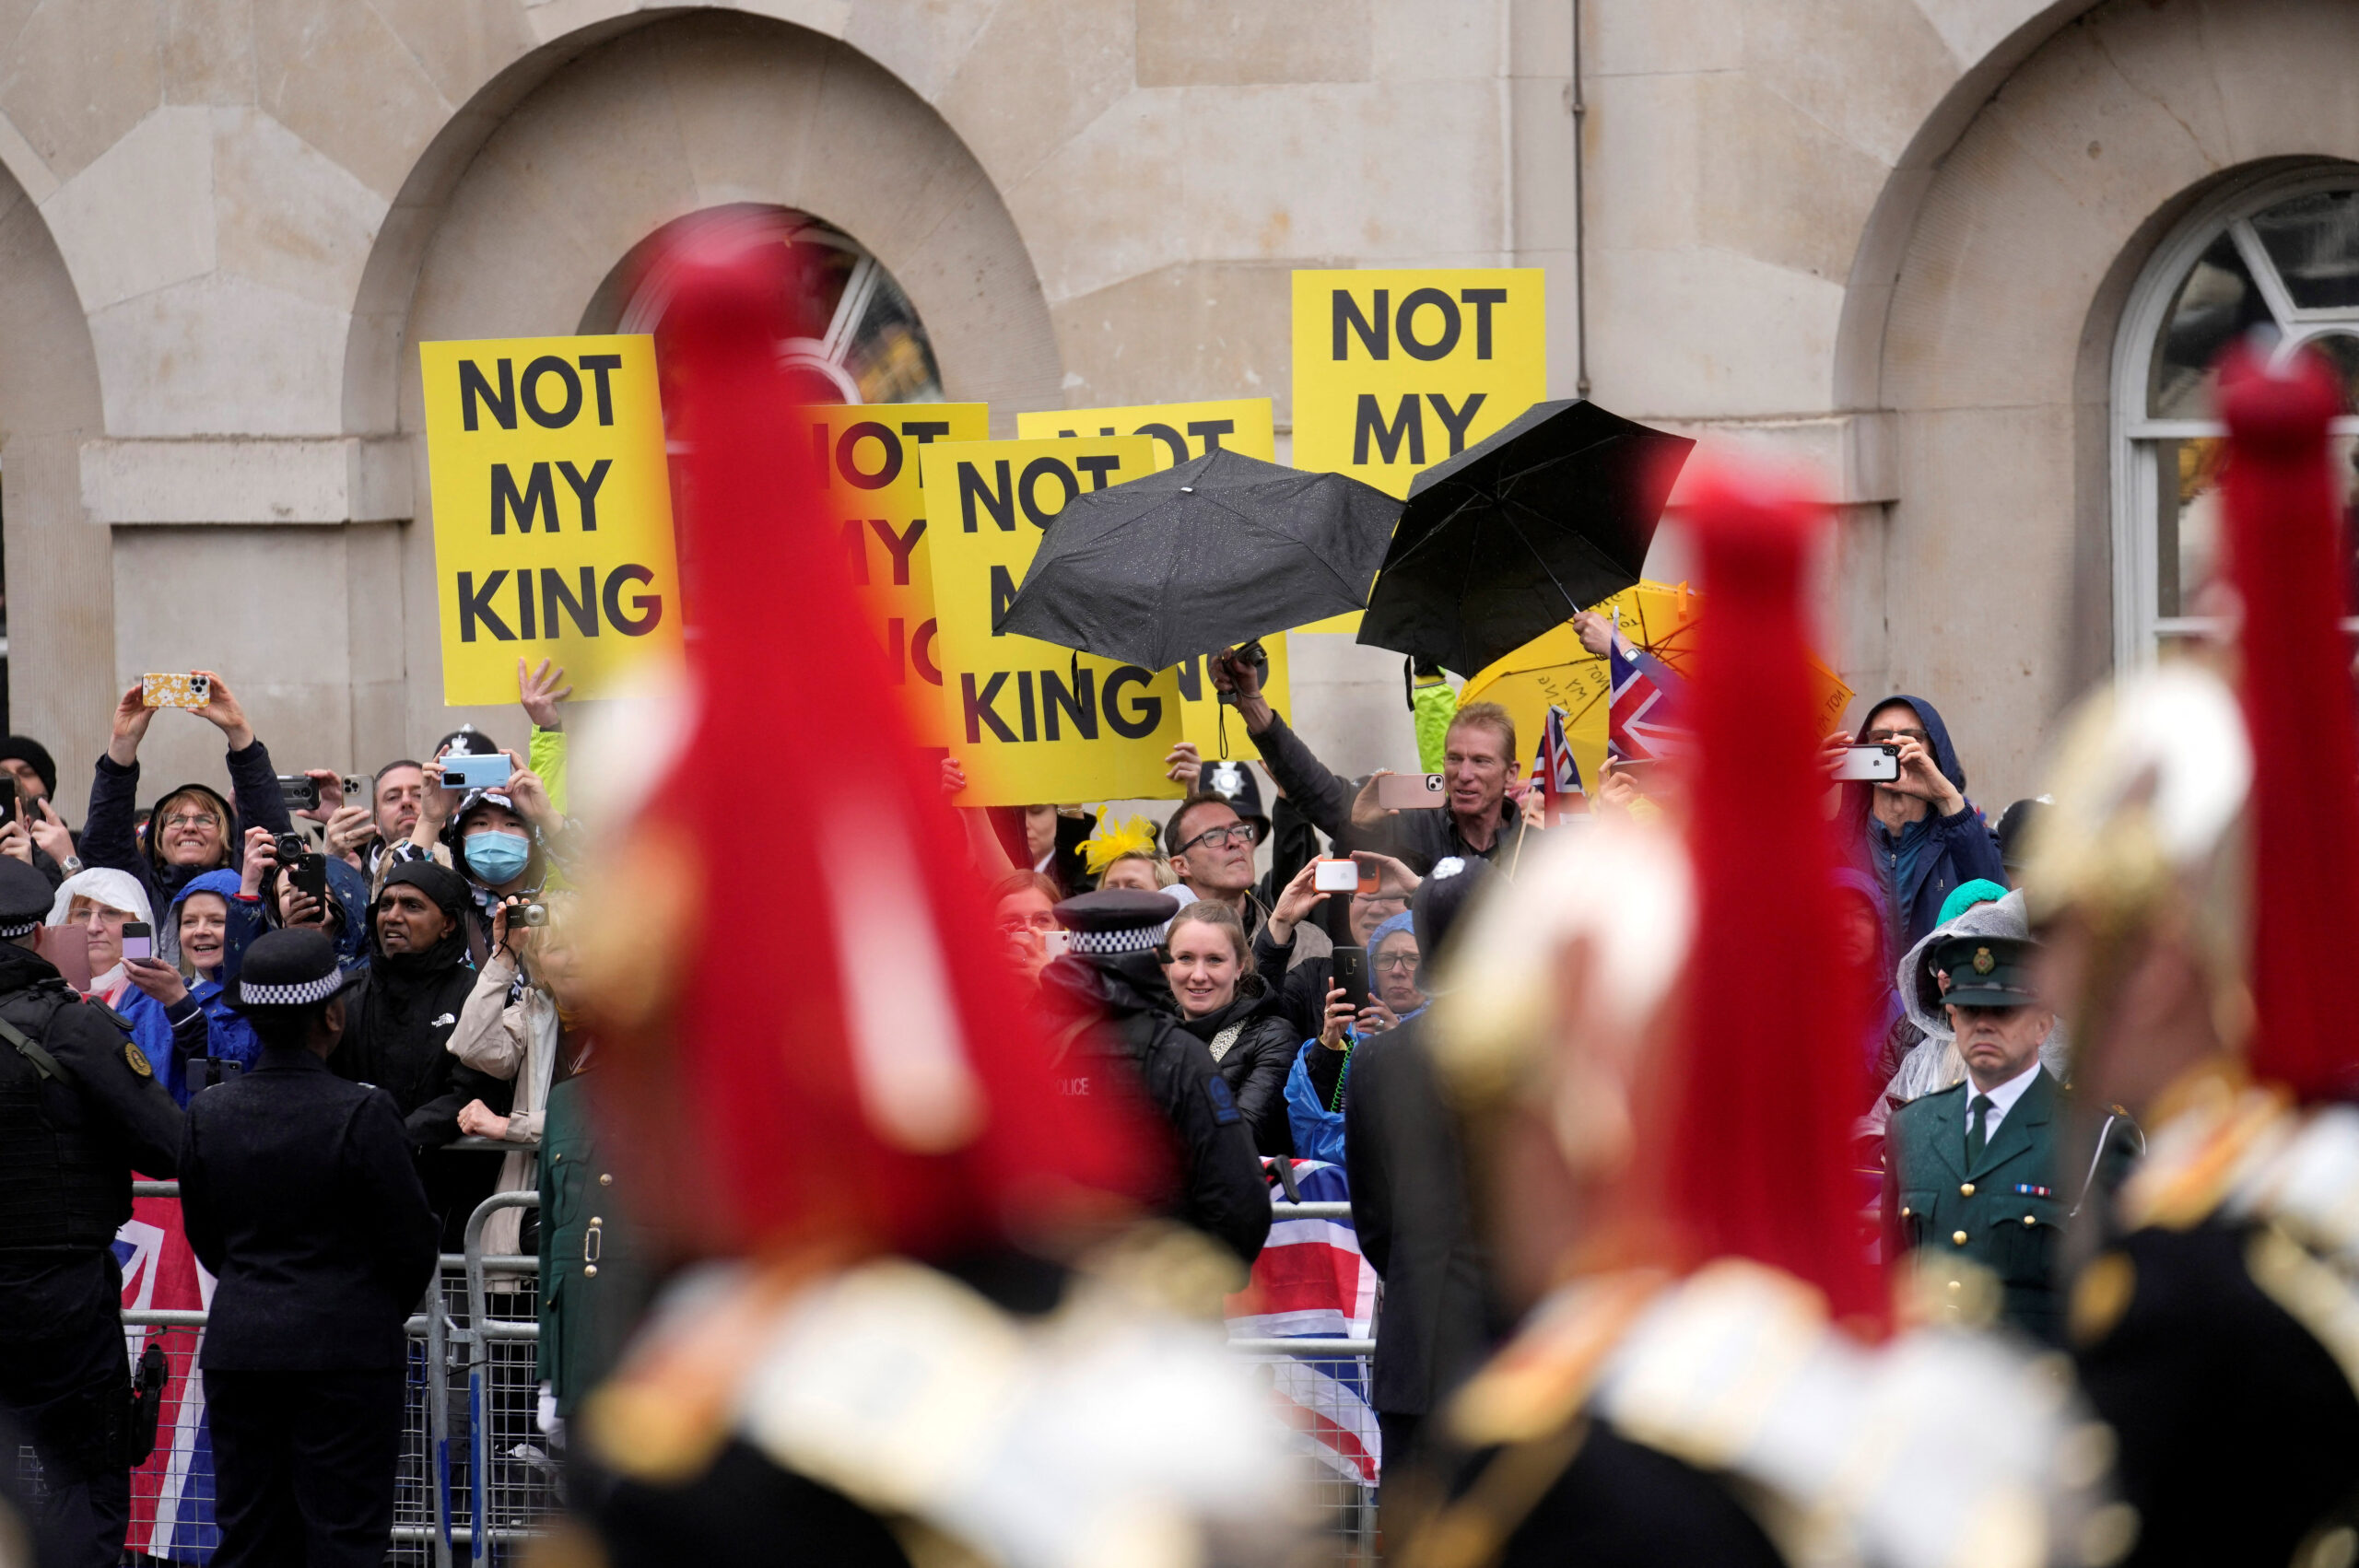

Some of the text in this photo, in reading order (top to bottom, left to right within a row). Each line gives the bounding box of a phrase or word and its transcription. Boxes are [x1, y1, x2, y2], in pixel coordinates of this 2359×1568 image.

[1332, 287, 1508, 361] NOT
[458, 354, 622, 432] NOT
[1352, 392, 1488, 465] MY
[489, 459, 614, 536] MY
[957, 454, 1121, 533] NOT
[457, 563, 663, 643] KING
[959, 664, 1163, 743] KING
[1056, 1077, 1090, 1095] OLICE
